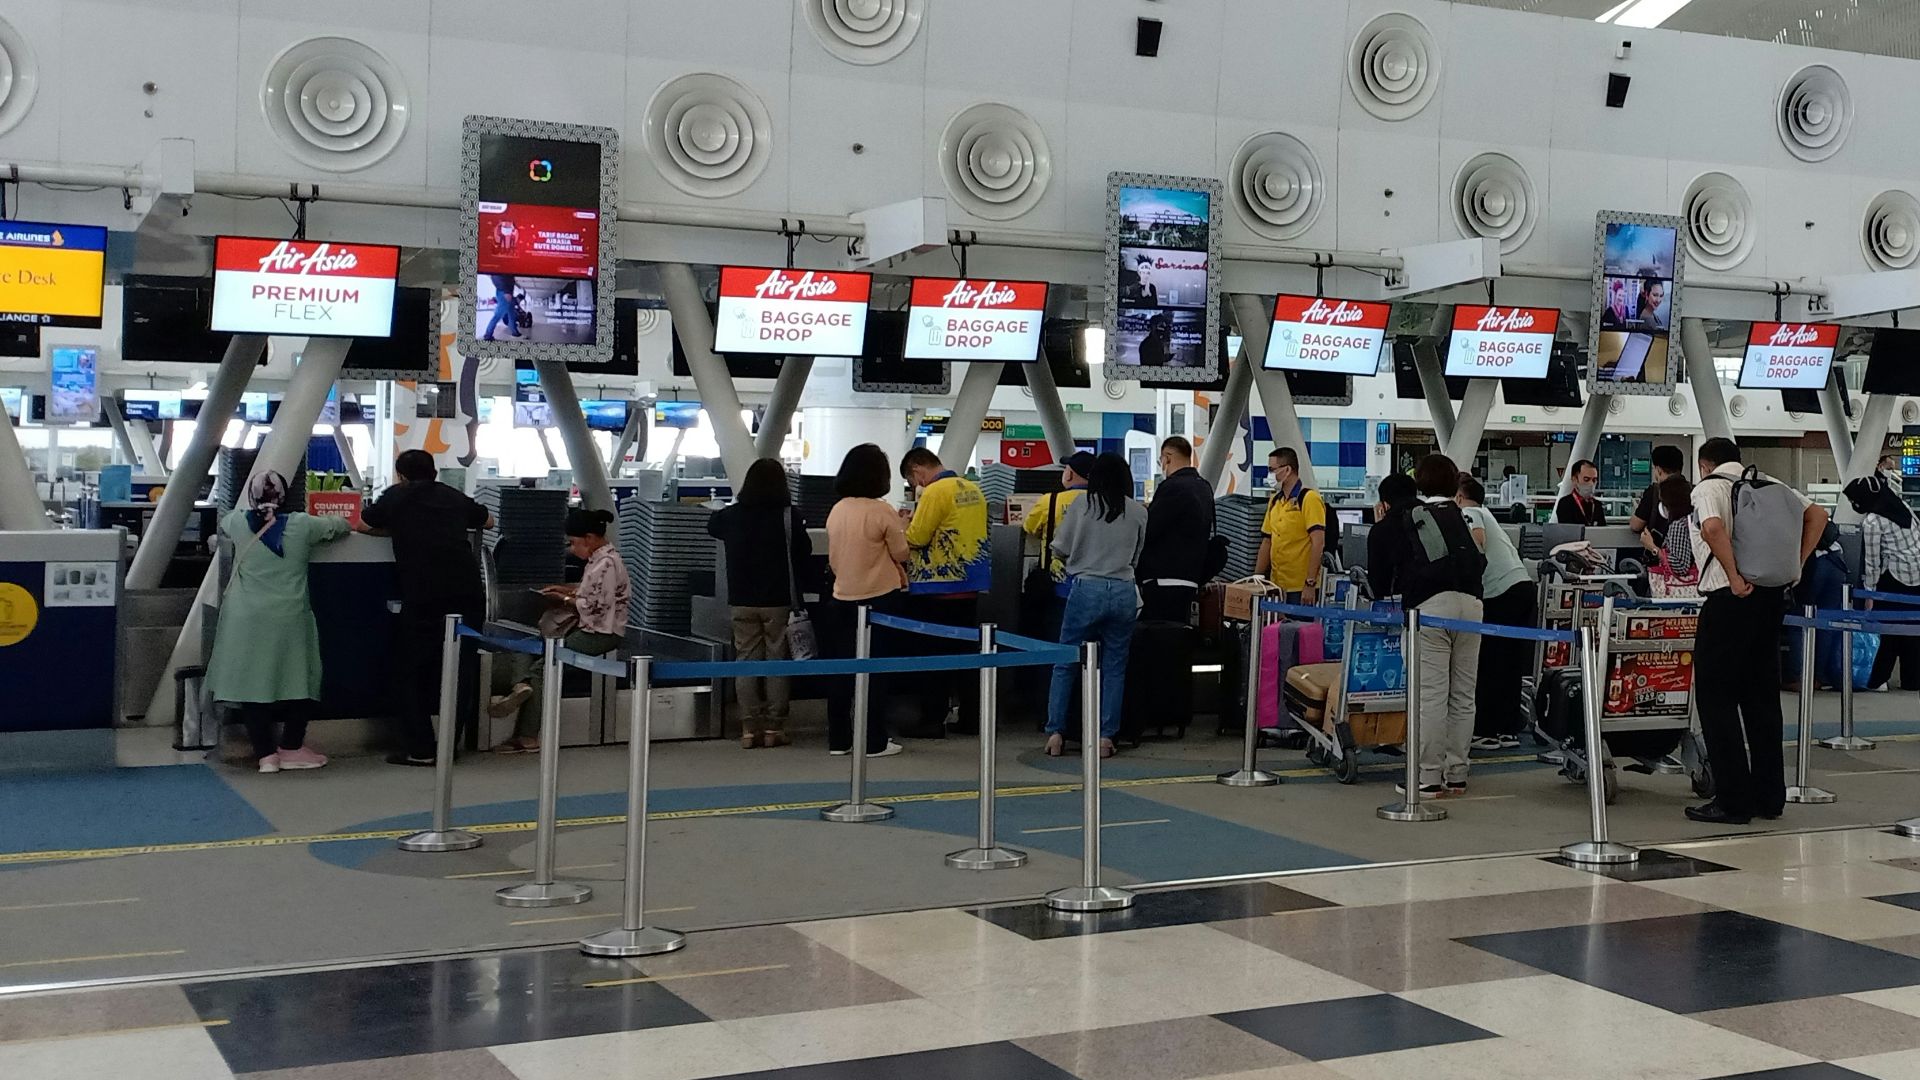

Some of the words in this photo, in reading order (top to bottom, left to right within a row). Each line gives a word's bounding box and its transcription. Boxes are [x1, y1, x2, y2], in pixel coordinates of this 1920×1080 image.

[6, 232, 51, 243] AIRLINES
[19, 269, 56, 286] Desk
[252, 284, 359, 304] PREMIUM
[274, 303, 334, 321] FLEX
[761, 310, 852, 327] BAGGAGE
[946, 318, 1029, 334] BAGGAGE
[759, 327, 812, 342] DROP
[944, 334, 993, 349] DROP
[1302, 333, 1372, 350] BAGGAGE
[1299, 347, 1340, 361] DROP
[1478, 341, 1543, 355] BAGGAGE
[1476, 355, 1514, 367] DROP
[1769, 355, 1824, 368] BAGGAGE
[1766, 367, 1799, 379] DROP
